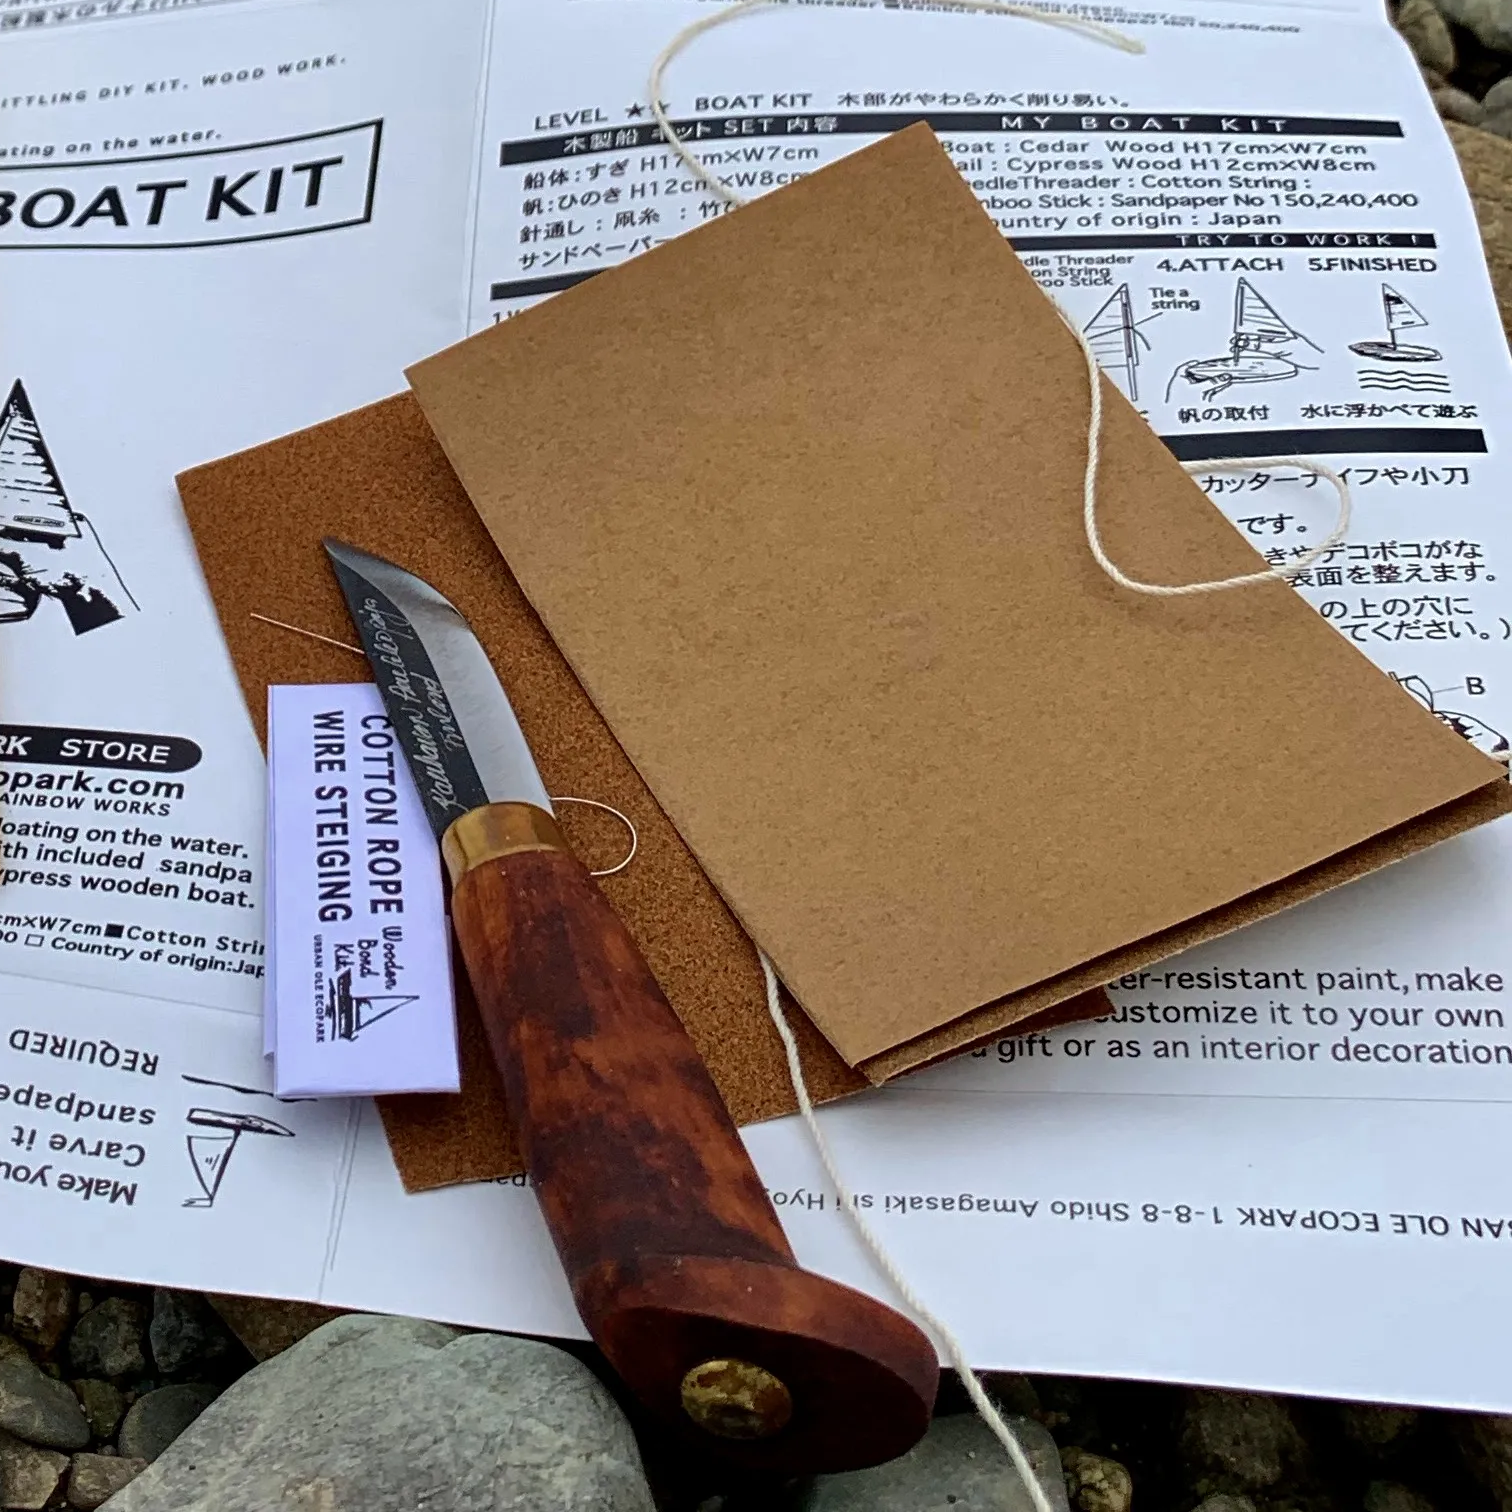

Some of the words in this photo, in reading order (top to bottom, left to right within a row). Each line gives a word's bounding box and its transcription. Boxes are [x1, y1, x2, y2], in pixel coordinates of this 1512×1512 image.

[98, 84, 133, 99] DIY
[144, 78, 188, 94] KIT.
[201, 67, 265, 86] WOOD
[276, 54, 345, 75] WORK.
[534, 107, 608, 131] LEVEL
[694, 94, 764, 112] BOAT
[772, 92, 813, 108] KIT
[1001, 115, 1051, 130] MY
[1080, 116, 1192, 131] BOAT
[1221, 118, 1289, 133] KIT
[64, 142, 92, 154] on
[102, 137, 139, 151] the
[149, 129, 222, 146] water.
[563, 129, 638, 155] 木製船
[723, 117, 774, 134] SET
[788, 116, 837, 133] 内容
[1019, 139, 1090, 154] Cedar
[1104, 139, 1175, 159] Wood
[1006, 156, 1104, 177] Cypress
[1111, 156, 1182, 177] Wood
[205, 155, 345, 222] KIT
[1140, 173, 1223, 189] Cotton
[1227, 174, 1298, 192] String
[1038, 193, 1092, 209] Stick
[1110, 192, 1229, 210] Sandpaper
[1232, 193, 1265, 207] No
[1269, 189, 1419, 209] 150,240,400
[1176, 233, 1230, 246] TRY
[1248, 233, 1288, 246] TO
[1305, 233, 1391, 246] WORK
[1156, 256, 1284, 274] 4.ATTACH
[1149, 287, 1177, 299] Tie
[1178, 289, 1190, 299] a
[1151, 297, 1201, 312] string
[1465, 676, 1486, 696] B
[59, 737, 171, 765] STORE
[313, 709, 346, 774] WIRE
[360, 714, 399, 826] COTTON
[93, 797, 171, 817] WORKS
[84, 826, 115, 843] on
[125, 826, 163, 847] the
[169, 834, 249, 859] water.
[315, 785, 353, 924] STEIGING
[366, 838, 404, 916] ROPE
[313, 933, 324, 969] URBAN
[313, 972, 325, 991] OLE
[1316, 966, 1409, 996] paint,
[1414, 965, 1504, 993] make
[314, 993, 326, 1043] ECOPARK
[1268, 999, 1293, 1025] it
[1301, 1002, 1338, 1026] to
[1347, 1007, 1424, 1032] your
[1434, 1007, 1504, 1028] own
[8, 1028, 159, 1076] REQUIRED
[996, 1030, 1054, 1064] gift
[1062, 1038, 1097, 1057] or
[1106, 1039, 1142, 1058] as
[1152, 1039, 1190, 1059] an
[1200, 1034, 1321, 1062] interior
[1330, 1029, 1512, 1065] decoration
[56, 1172, 138, 1206] Make
[884, 1193, 1039, 1218] Amagasaki
[1141, 1203, 1223, 1225] 1-8-8
[1236, 1206, 1380, 1233] ECOPARK
[1389, 1213, 1450, 1237] OLE
